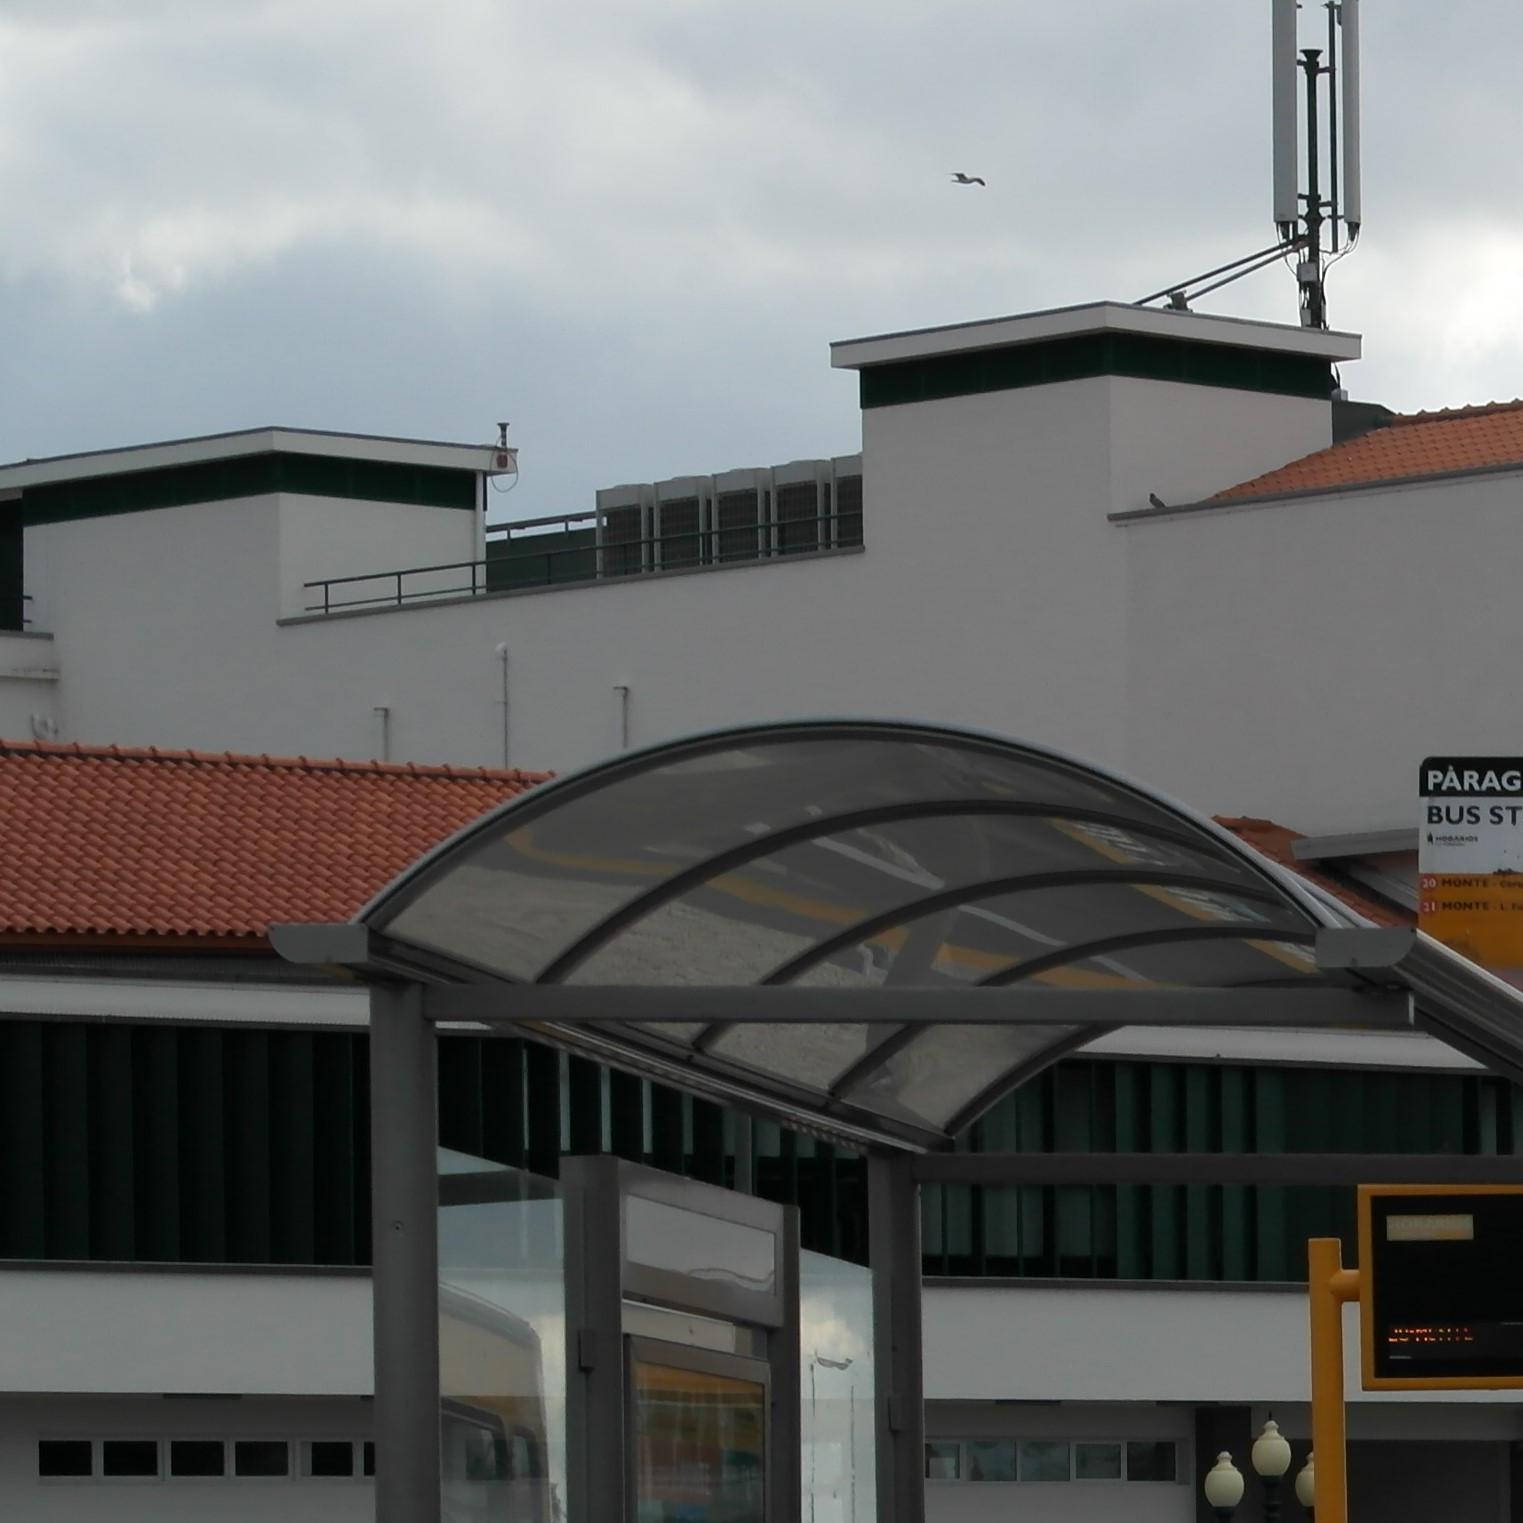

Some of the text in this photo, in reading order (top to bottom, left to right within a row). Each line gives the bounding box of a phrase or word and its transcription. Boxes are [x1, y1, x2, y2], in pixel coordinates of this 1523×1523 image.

[1427, 806, 1481, 826] BUS
[1442, 878, 1488, 889] MONTE
[1442, 902, 1488, 912] MONTE
